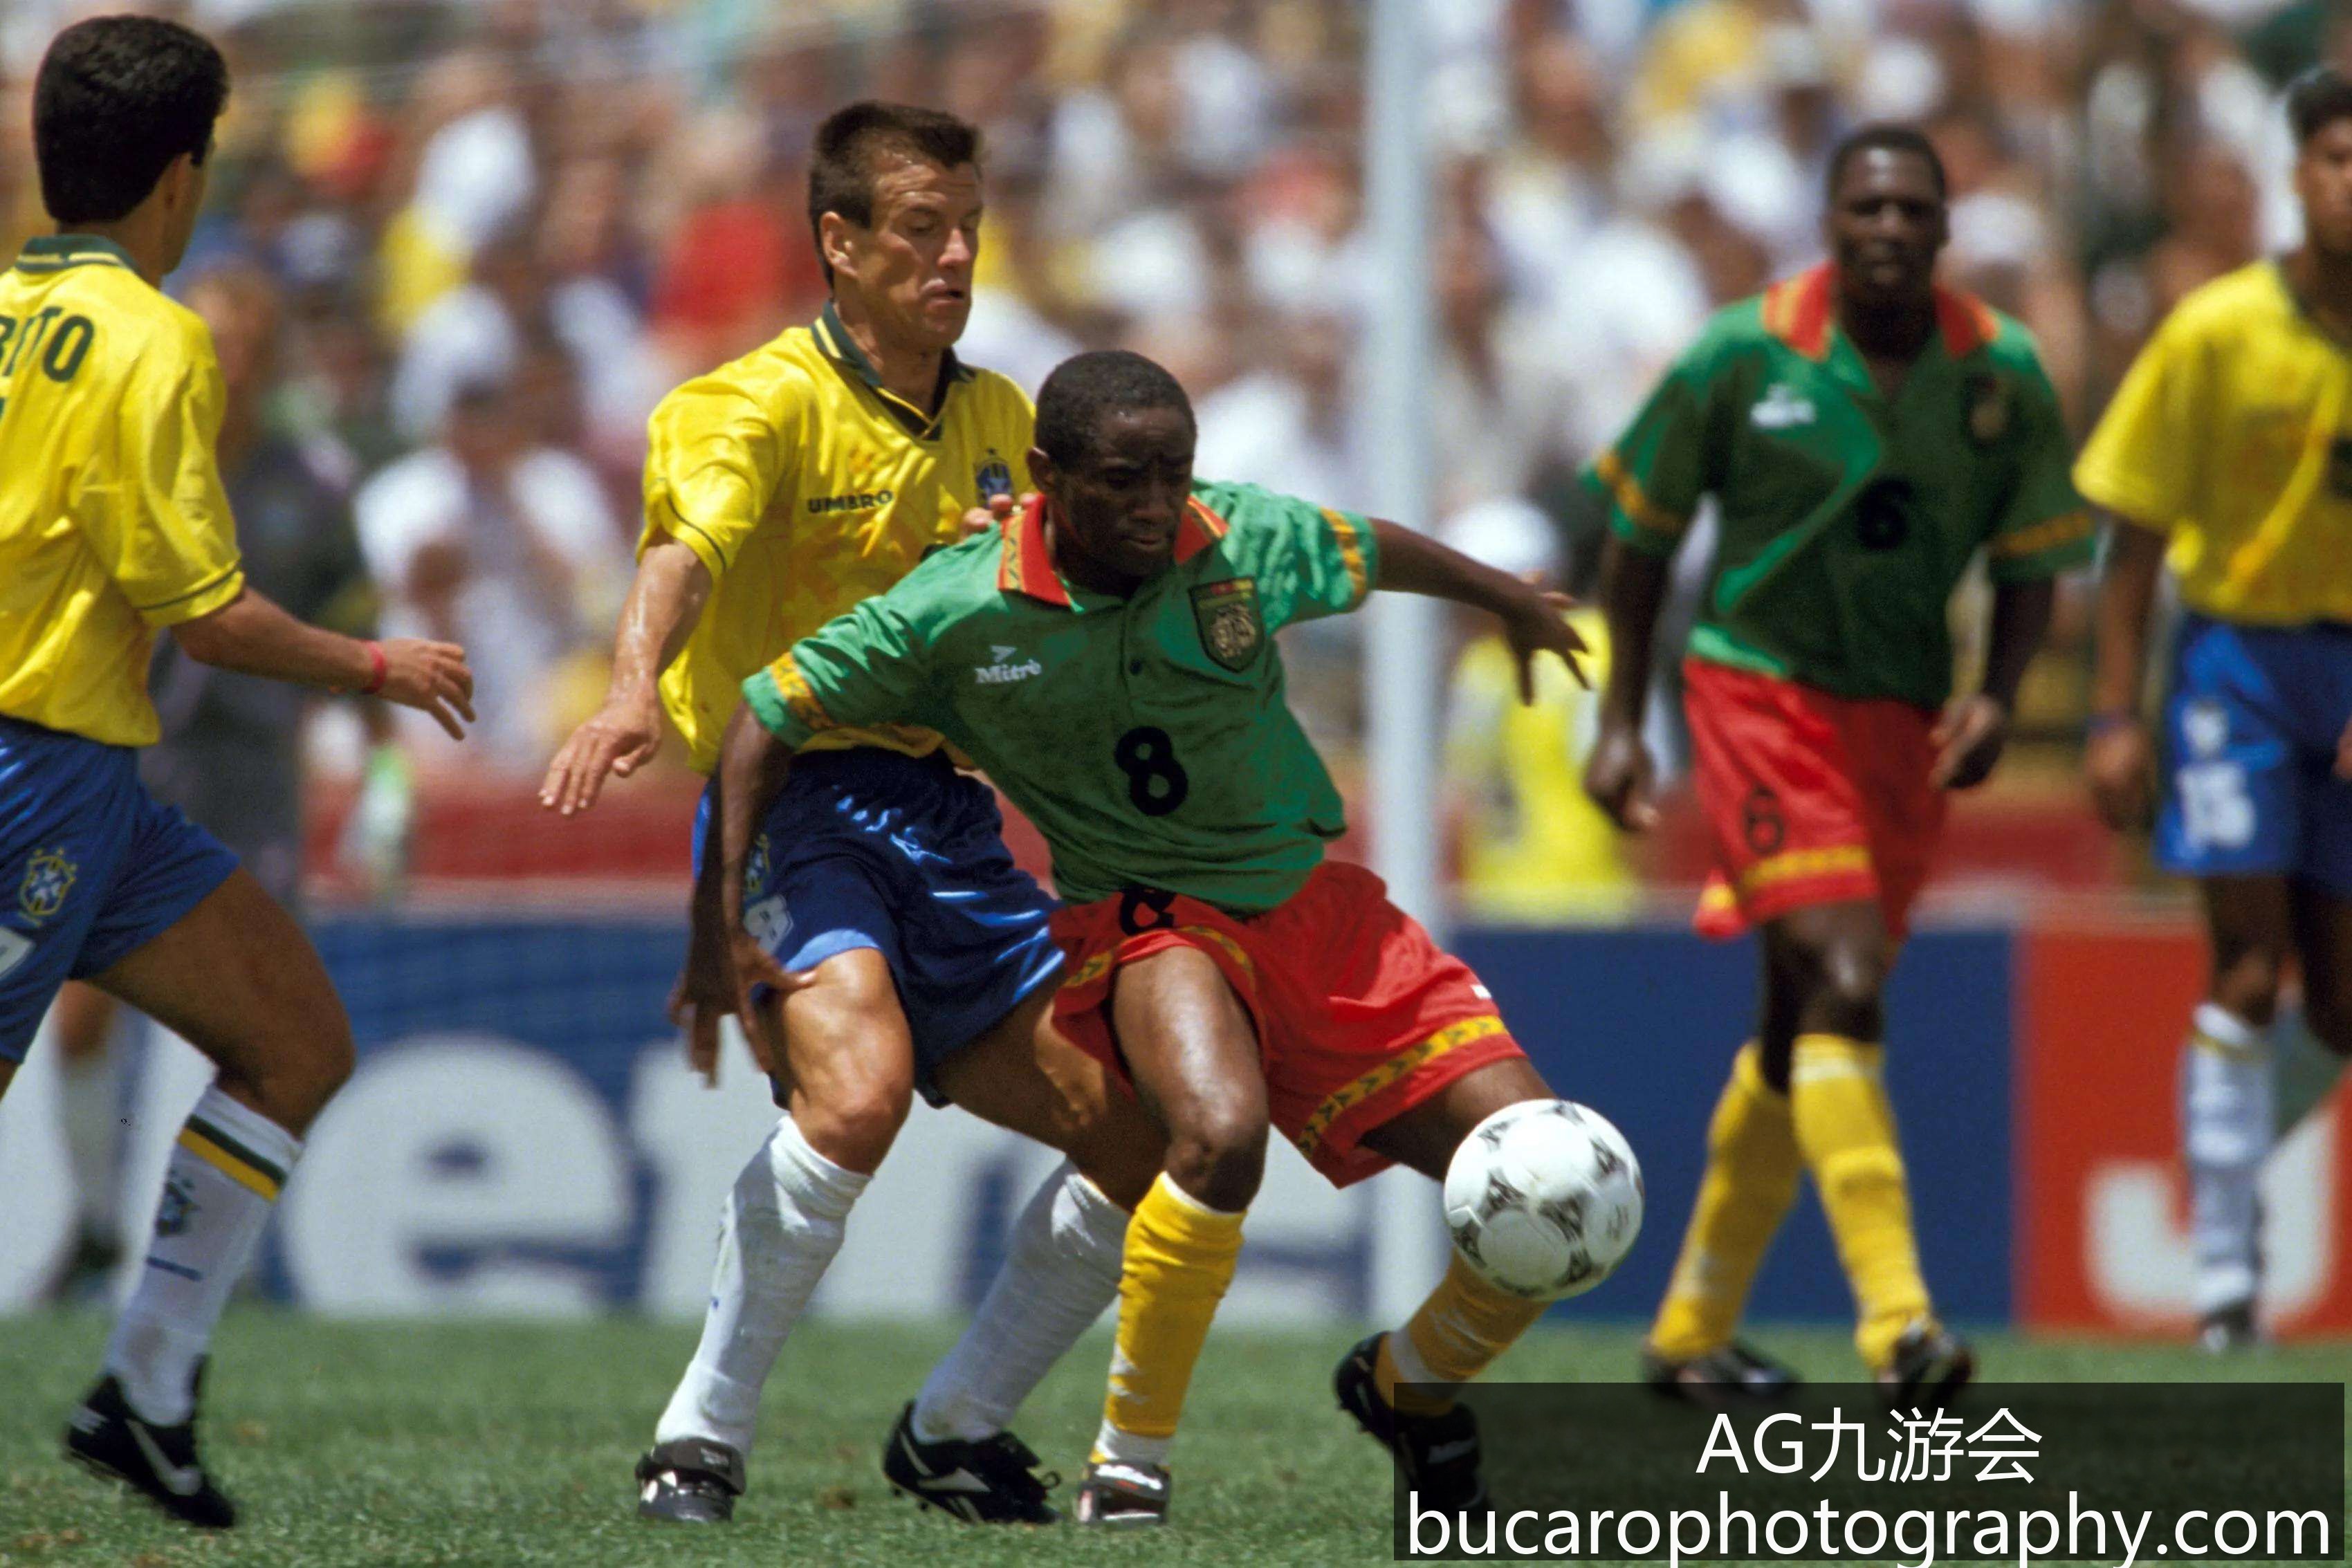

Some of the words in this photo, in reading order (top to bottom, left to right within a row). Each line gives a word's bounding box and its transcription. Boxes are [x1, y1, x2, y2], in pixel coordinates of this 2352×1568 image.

[808, 490, 892, 513] UMBRO
[1855, 476, 1913, 551] 6
[1114, 726, 1188, 816] 8
[1743, 784, 1785, 854] 6
